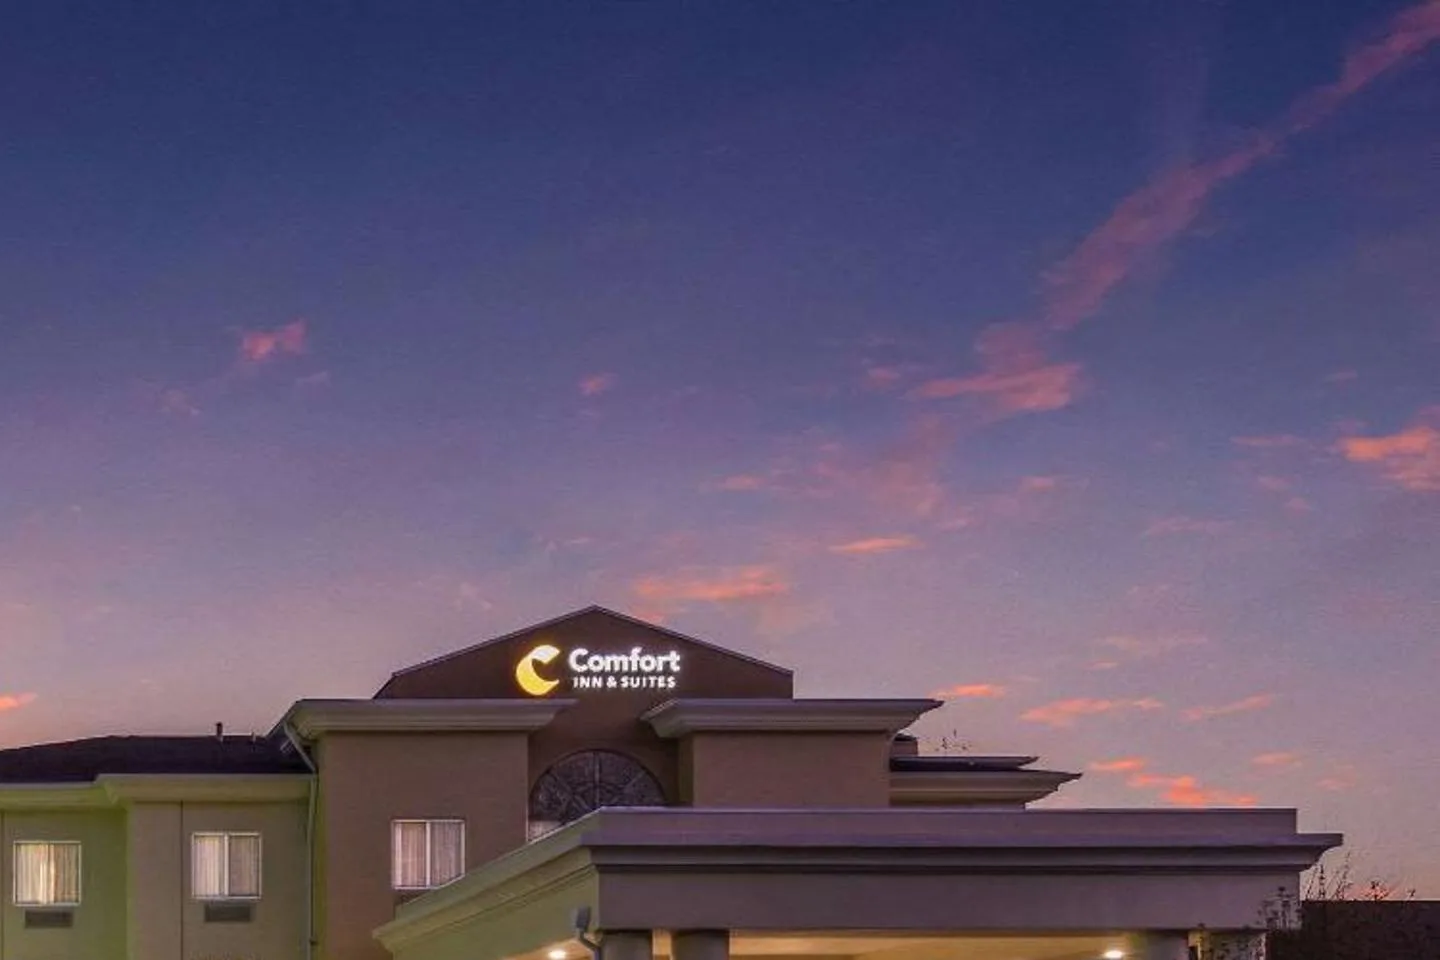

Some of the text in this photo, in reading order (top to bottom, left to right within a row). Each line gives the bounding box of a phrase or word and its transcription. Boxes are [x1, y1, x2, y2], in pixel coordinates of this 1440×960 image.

[568, 646, 681, 673] Comfort
[573, 675, 677, 689] INN & SUITES
